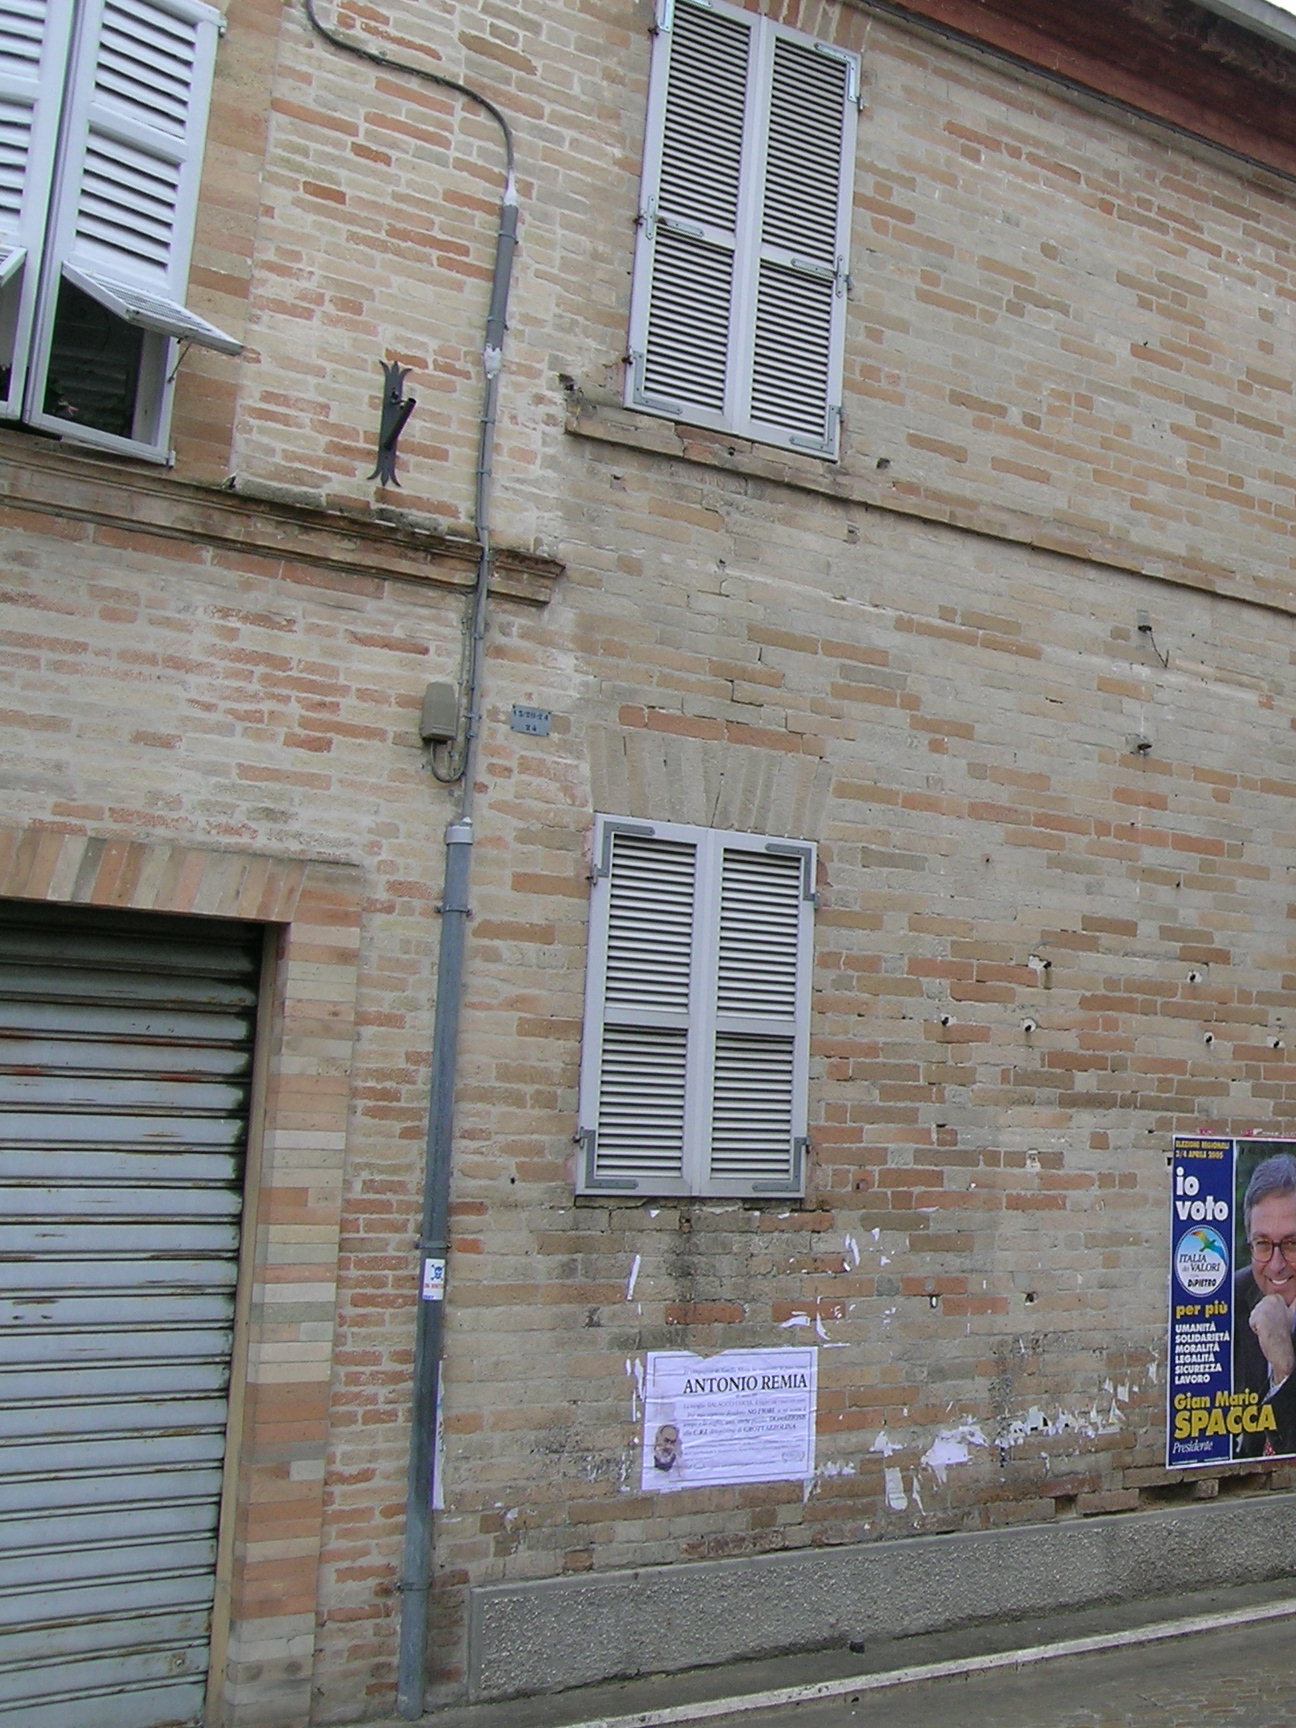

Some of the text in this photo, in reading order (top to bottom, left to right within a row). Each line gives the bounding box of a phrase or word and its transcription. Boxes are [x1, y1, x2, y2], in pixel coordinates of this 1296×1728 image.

[1176, 1166, 1200, 1196] io
[1175, 1195, 1229, 1221] voto
[1179, 1254, 1207, 1263] ITALIA
[1190, 1263, 1220, 1272] VALORI
[1176, 1300, 1228, 1319] per più
[1175, 1321, 1216, 1333] UMANITÀ
[1175, 1330, 1230, 1343] SOLIDARIETÀ
[1175, 1341, 1220, 1353] MORALITÀ
[1175, 1352, 1215, 1364] LEGALITÀ
[1174, 1363, 1222, 1374] SICUREZZA
[683, 1373, 808, 1394] ANTONIO REMIA
[1175, 1374, 1210, 1385] LAVORO
[1174, 1388, 1259, 1410] Gian Mario
[1174, 1404, 1277, 1439] SPACCA
[1172, 1439, 1213, 1454] Presidente
